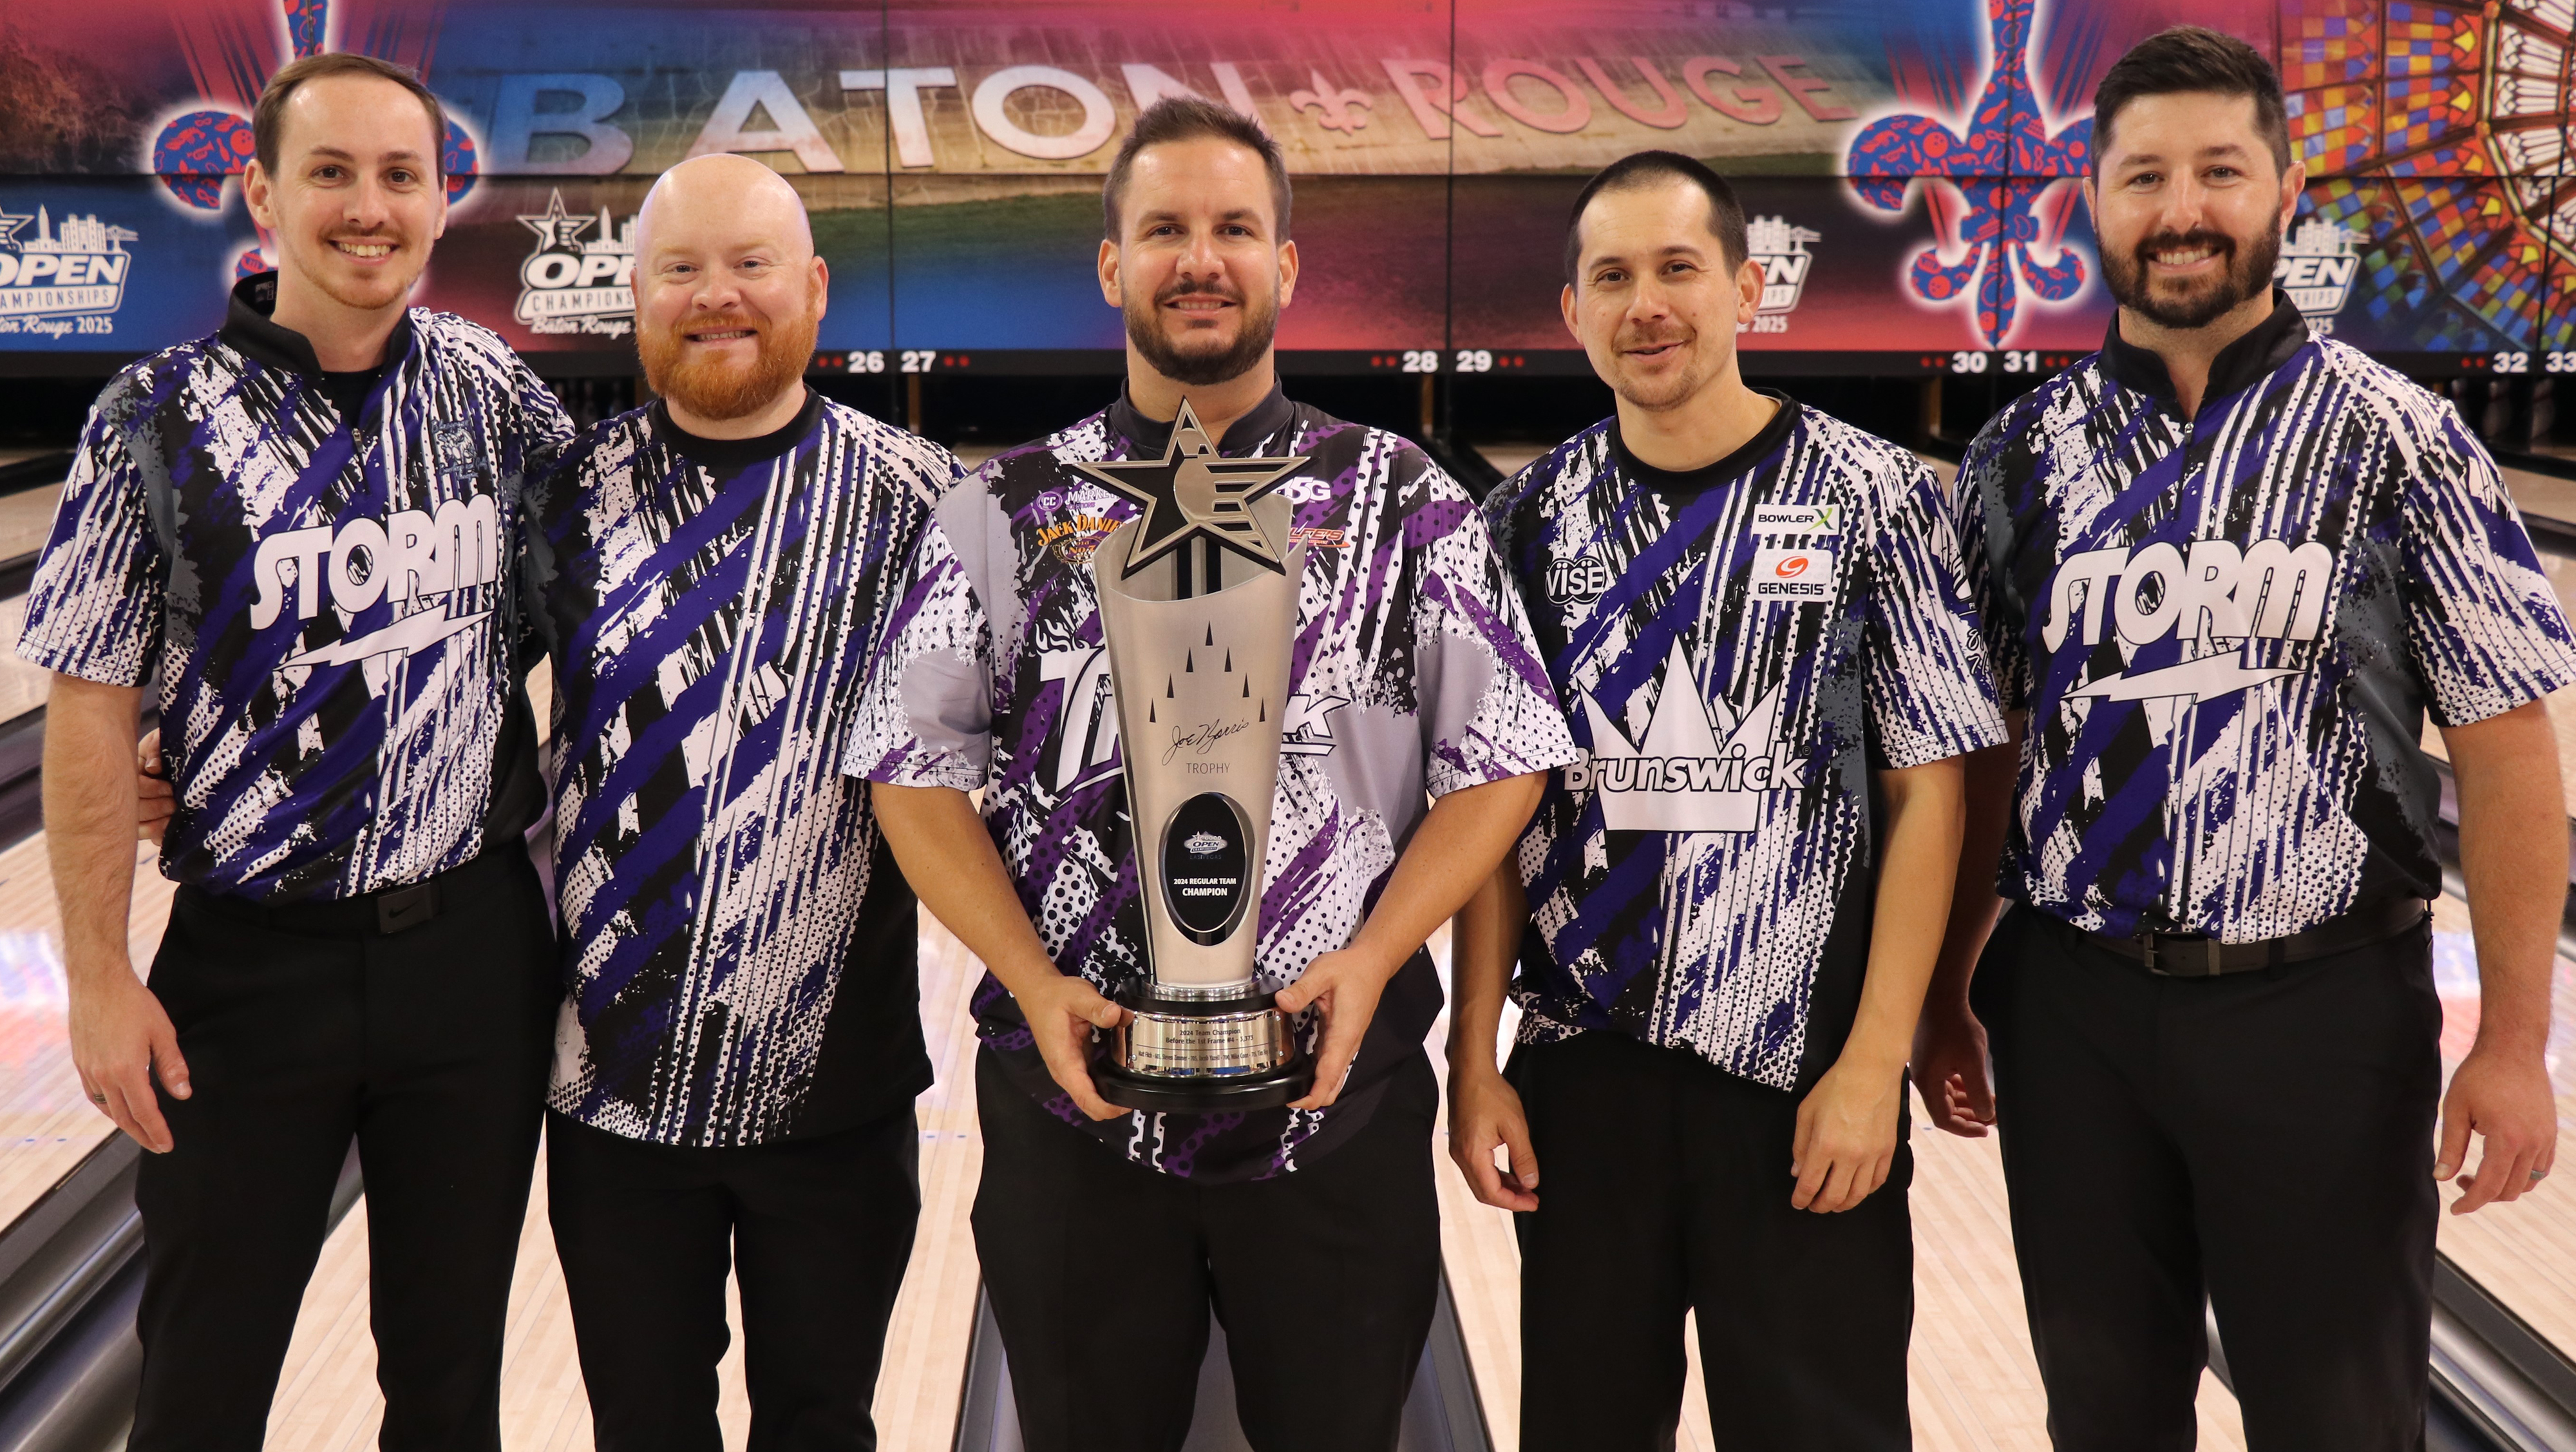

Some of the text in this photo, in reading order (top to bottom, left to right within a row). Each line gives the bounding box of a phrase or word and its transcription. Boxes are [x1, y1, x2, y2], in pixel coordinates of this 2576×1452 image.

[1380, 54, 1859, 140] ROUGE
[0, 289, 109, 309] AMPIONSHIPS
[533, 291, 634, 312] CHAMPIONS
[22, 314, 74, 340] Rouge
[76, 316, 113, 334] 2025
[531, 314, 631, 339] Baton Rouge
[848, 350, 885, 373] 26
[901, 350, 936, 372] 27
[1402, 350, 1439, 373] 28
[1455, 350, 1492, 372] 29
[1951, 351, 1988, 373] 30
[2003, 350, 2038, 372] 31
[2492, 351, 2528, 373] 32
[1043, 497, 1056, 506] CC
[1036, 519, 1075, 546] JACK
[251, 494, 498, 629] STORM
[1758, 583, 1824, 595] GENESIS
[2042, 539, 2333, 653] STORM
[1162, 725, 1197, 766] Joe
[1186, 763, 1231, 774] TROPHY
[1564, 742, 1808, 792] Brunswick
[1182, 888, 1227, 896] CHAMPION
